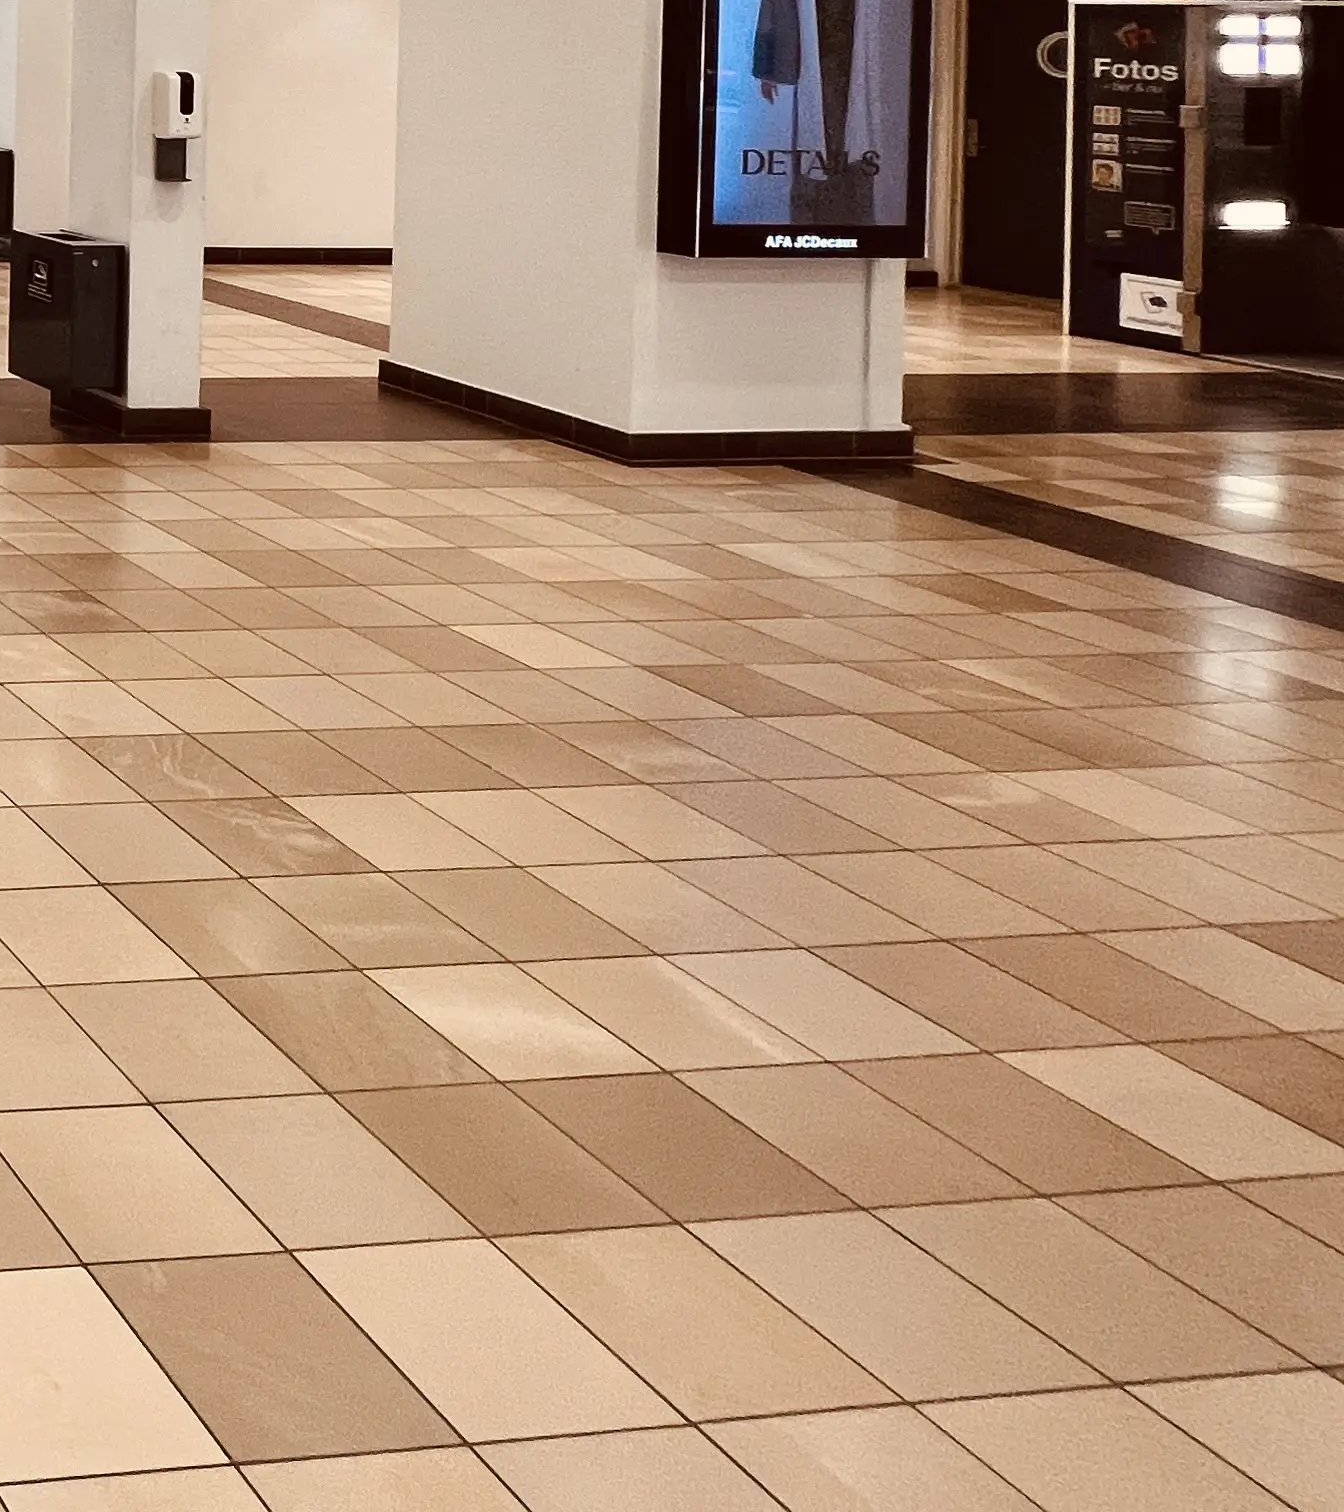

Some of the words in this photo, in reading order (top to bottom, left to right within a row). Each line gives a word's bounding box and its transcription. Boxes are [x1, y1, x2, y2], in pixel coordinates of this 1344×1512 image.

[1093, 56, 1179, 82] Fotos
[764, 235, 793, 248] AFA
[794, 235, 858, 249] JCDecaux
